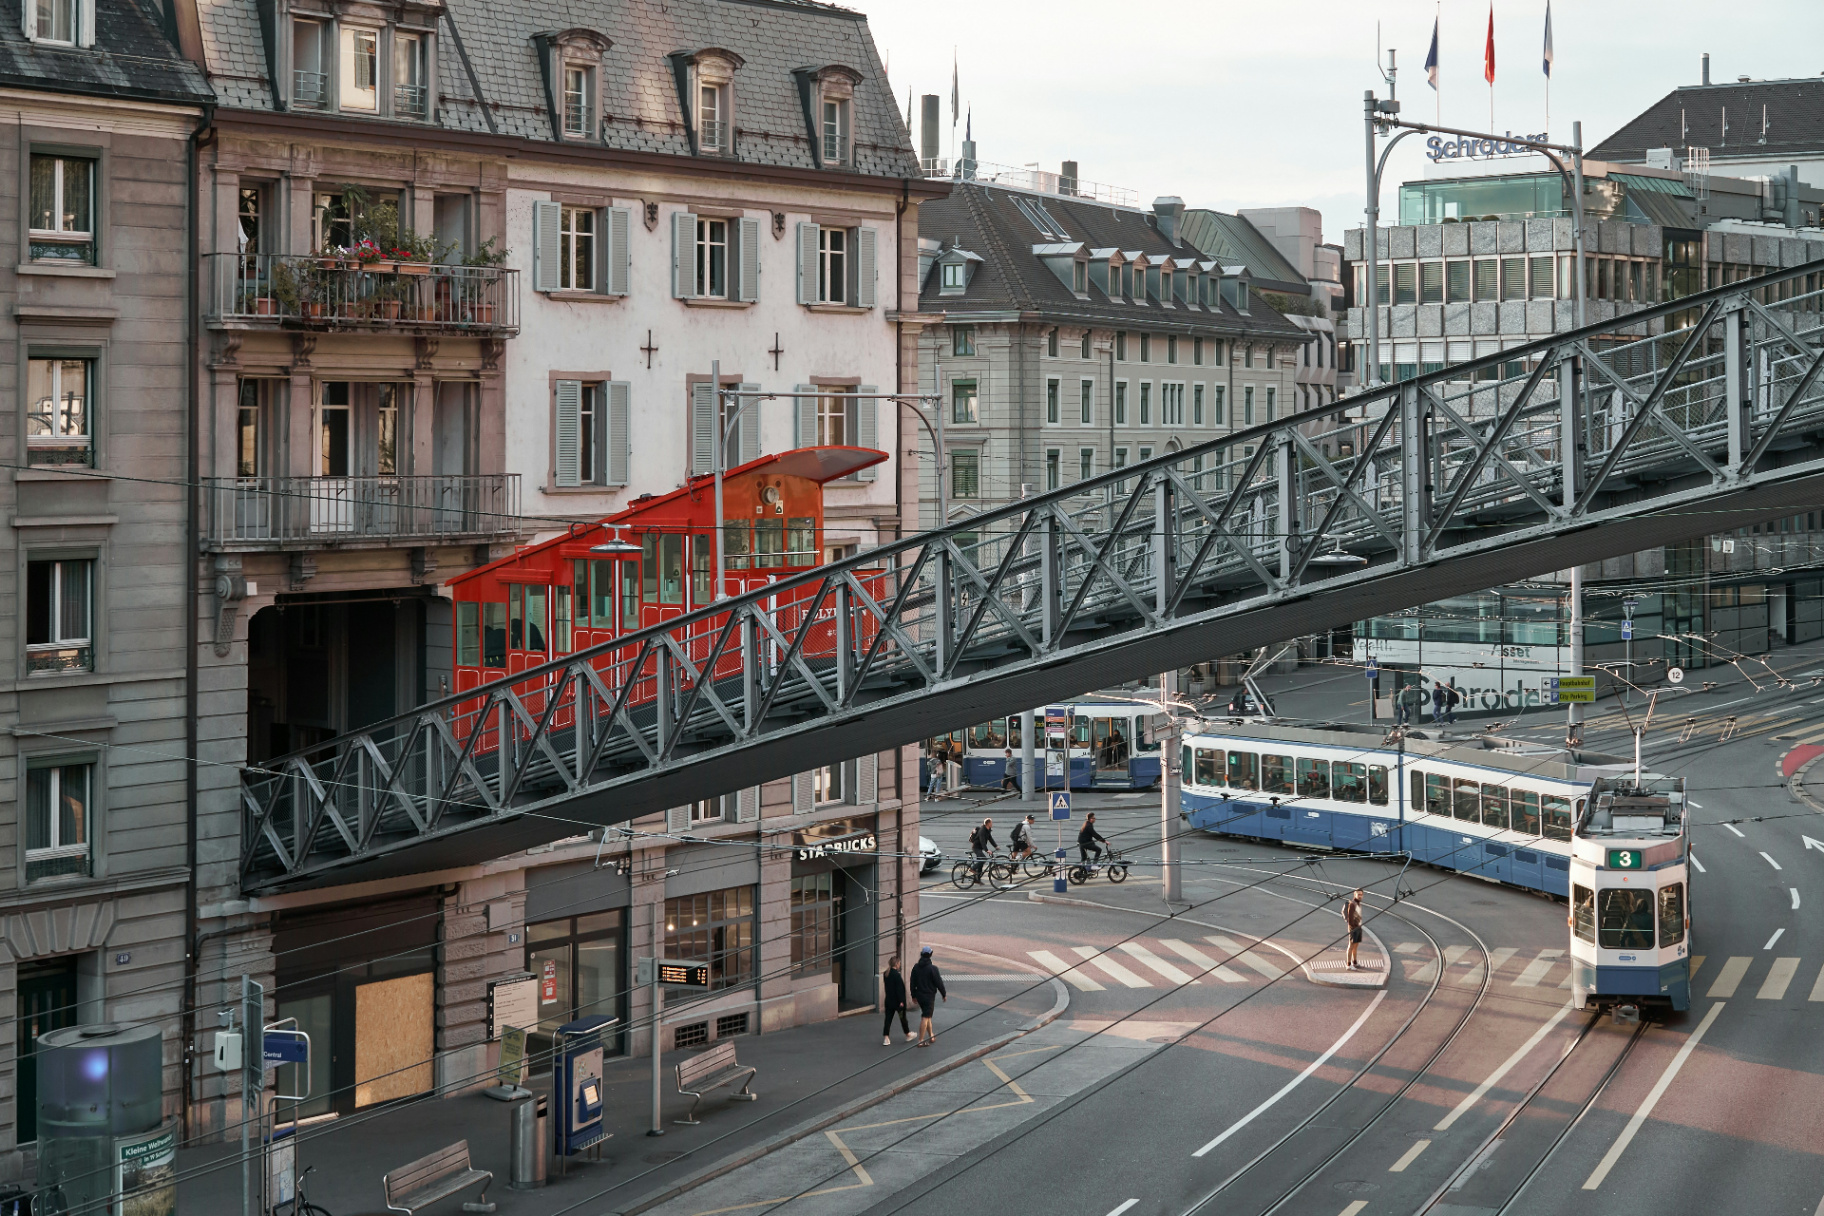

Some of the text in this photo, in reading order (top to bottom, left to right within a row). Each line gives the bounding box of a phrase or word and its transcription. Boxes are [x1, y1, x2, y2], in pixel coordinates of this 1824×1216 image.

[1672, 671, 1680, 679] 12
[1559, 680, 1591, 688] Hauptbahnhof
[1619, 851, 1632, 867] 3
[125, 1145, 147, 1156] Kleine
